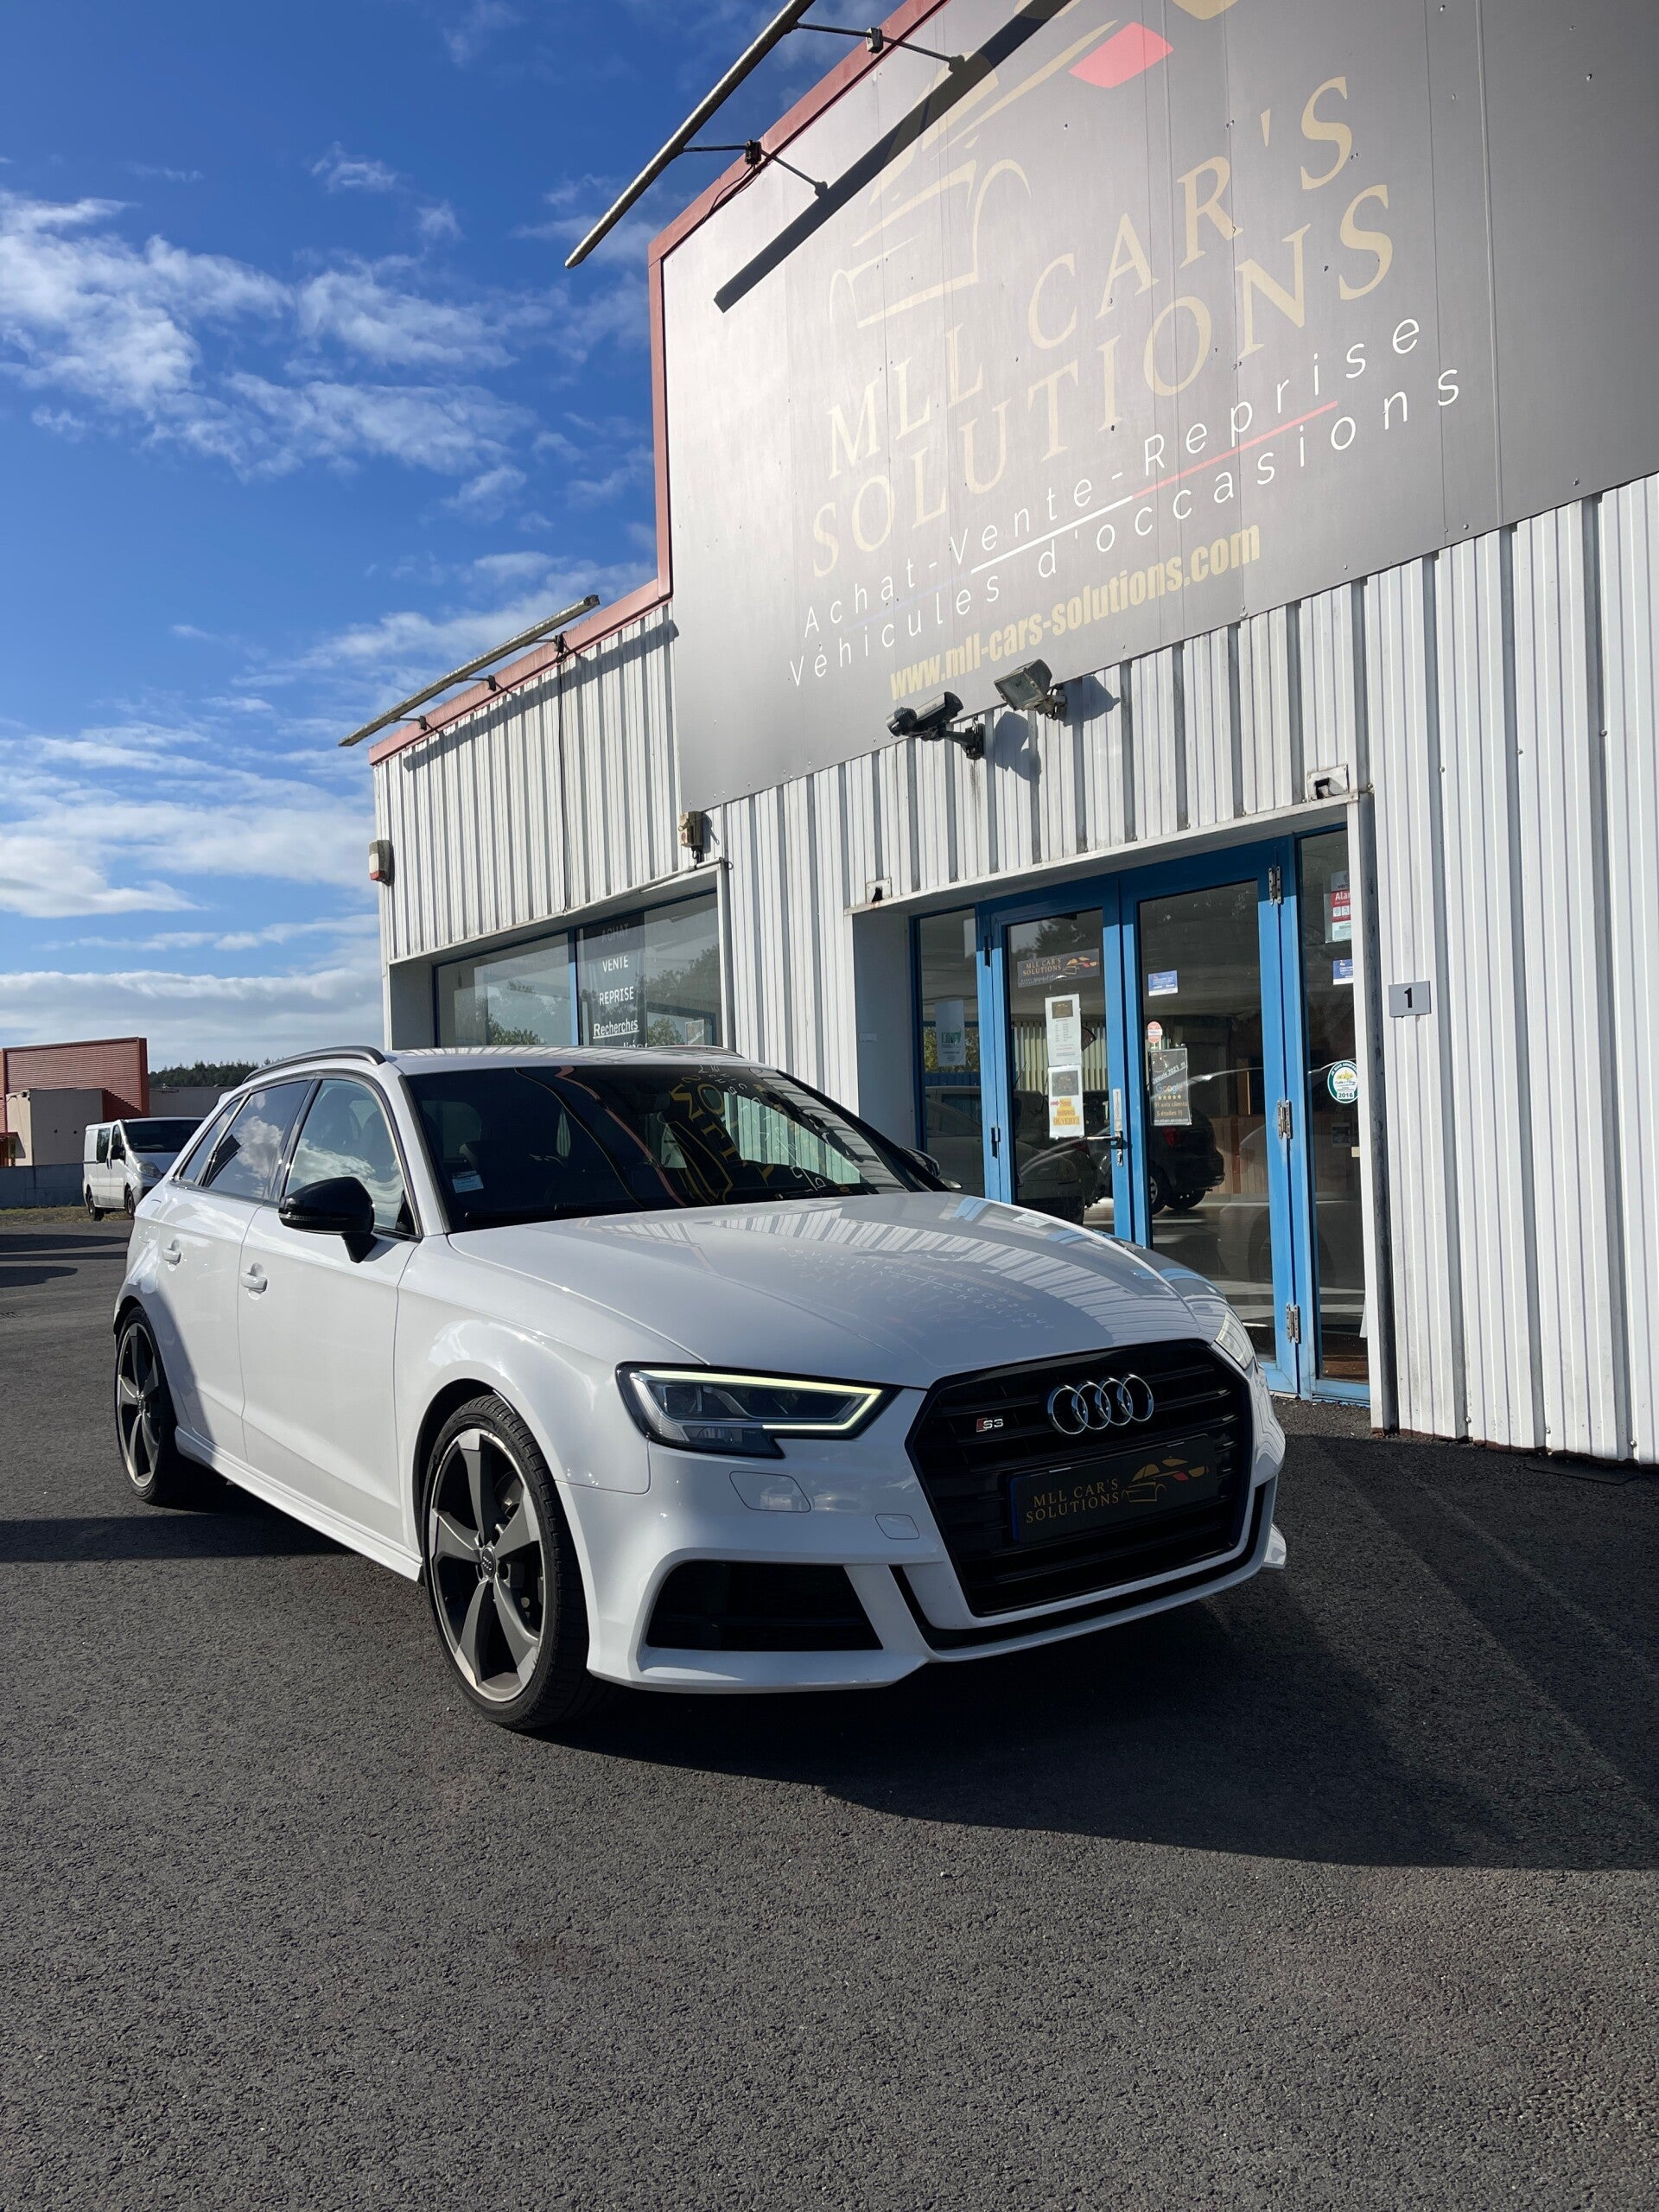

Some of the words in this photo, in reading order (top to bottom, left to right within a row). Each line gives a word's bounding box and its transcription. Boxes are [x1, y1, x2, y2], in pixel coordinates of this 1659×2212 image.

[825, 322, 983, 480] MLL
[1026, 74, 1355, 350] CAR'S
[810, 183, 1394, 578] SOLUTIONS
[804, 317, 1421, 639] Achat-Vente-Reprise
[789, 578, 1000, 688] Véhicules
[1038, 367, 1460, 580] d'occasions
[890, 524, 1262, 702] www.mll-cars-solutions.com
[601, 923, 629, 943] ACHAT
[602, 955, 629, 973] VENTE
[1022, 965, 1062, 976] SOLUTIONS
[599, 986, 634, 1007] REPRISE
[1404, 988, 1413, 1008] 1
[594, 1018, 639, 1038] Recherches
[1155, 1083, 1183, 1094] Google
[982, 1418, 1004, 1430] S3
[1033, 1490, 1067, 1508] MLL
[1073, 1478, 1118, 1498] CAR'S
[1026, 1491, 1120, 1523] SOLUTIONS
